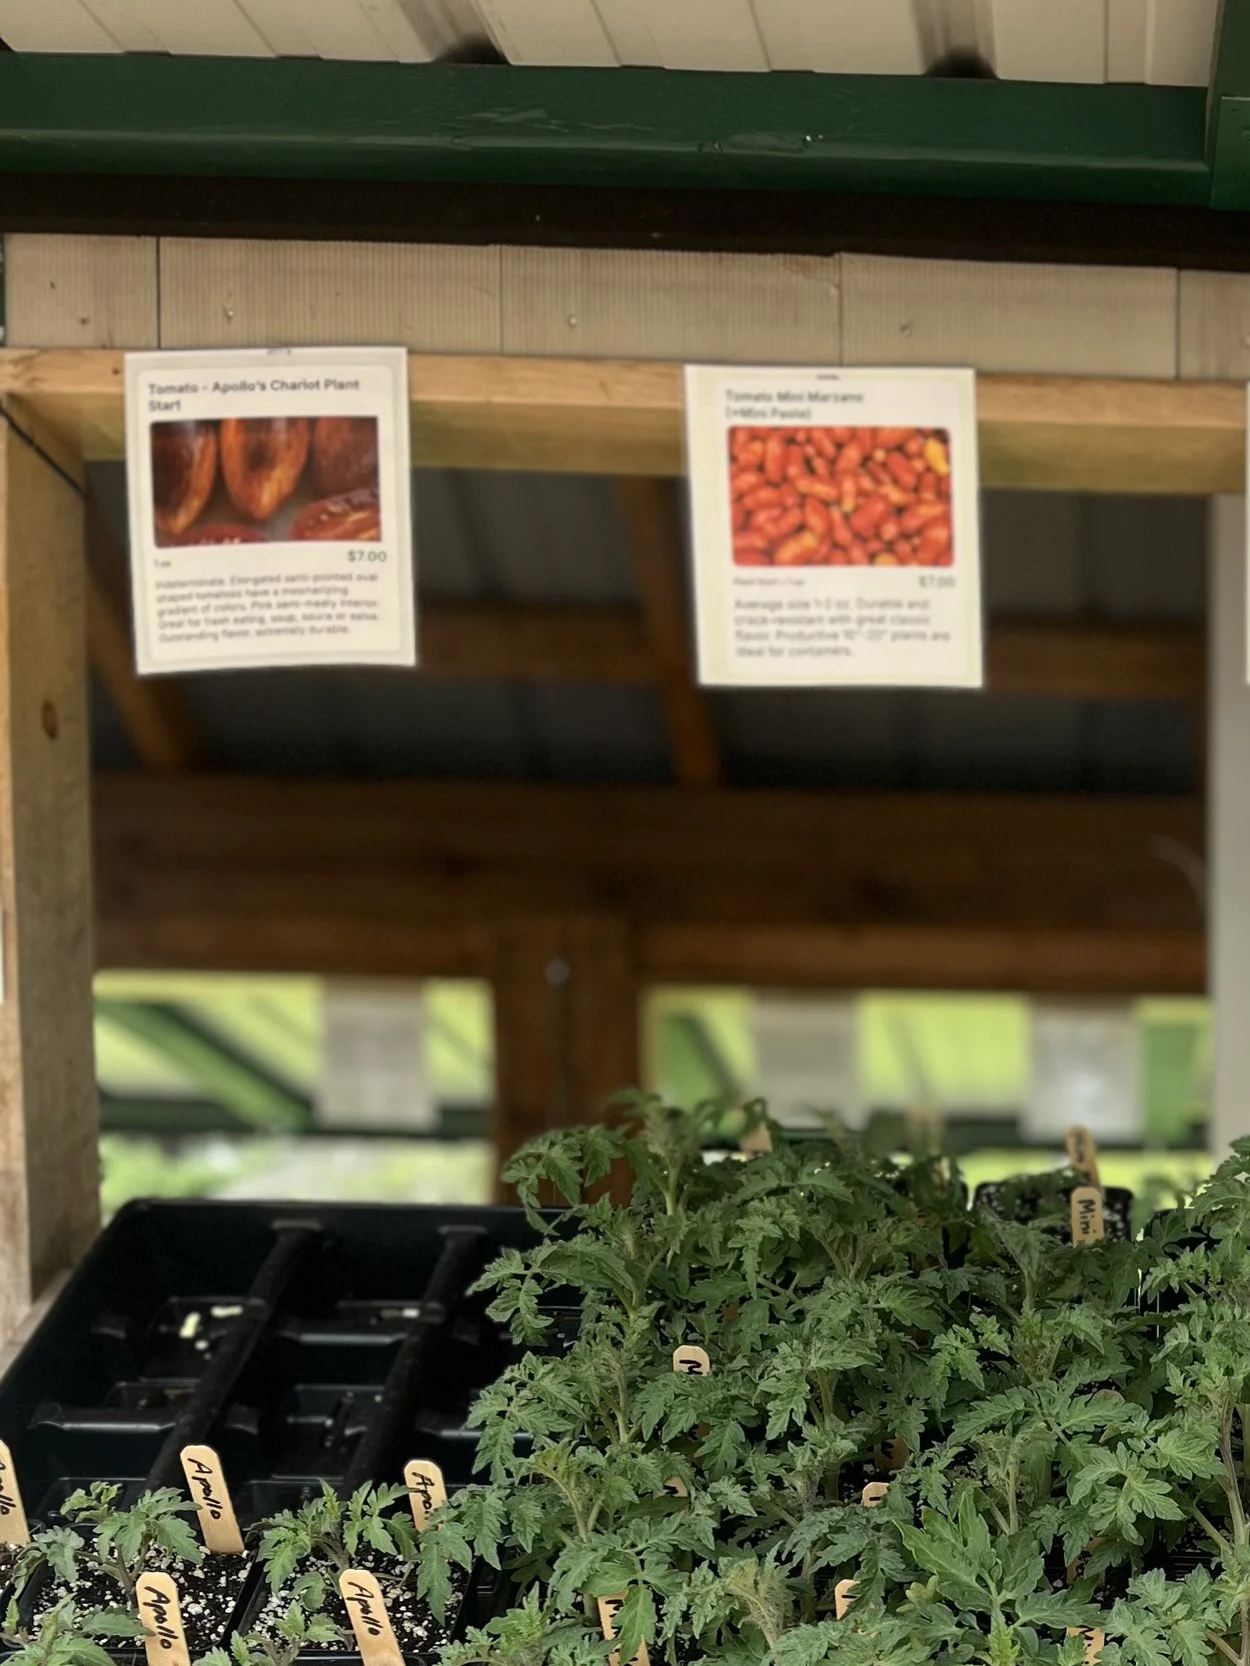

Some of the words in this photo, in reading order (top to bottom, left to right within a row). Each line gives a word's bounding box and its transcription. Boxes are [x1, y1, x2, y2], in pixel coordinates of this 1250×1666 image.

[148, 383, 198, 394] Tomato
[270, 379, 320, 391] Chariot
[323, 378, 359, 390] Plant
[148, 399, 181, 412] Start
[347, 549, 387, 562] $7.00
[1077, 1198, 1097, 1235] Mini
[187, 1456, 222, 1521] Apollo
[142, 1585, 173, 1650] Apollo
[346, 1580, 381, 1637] Apollo
